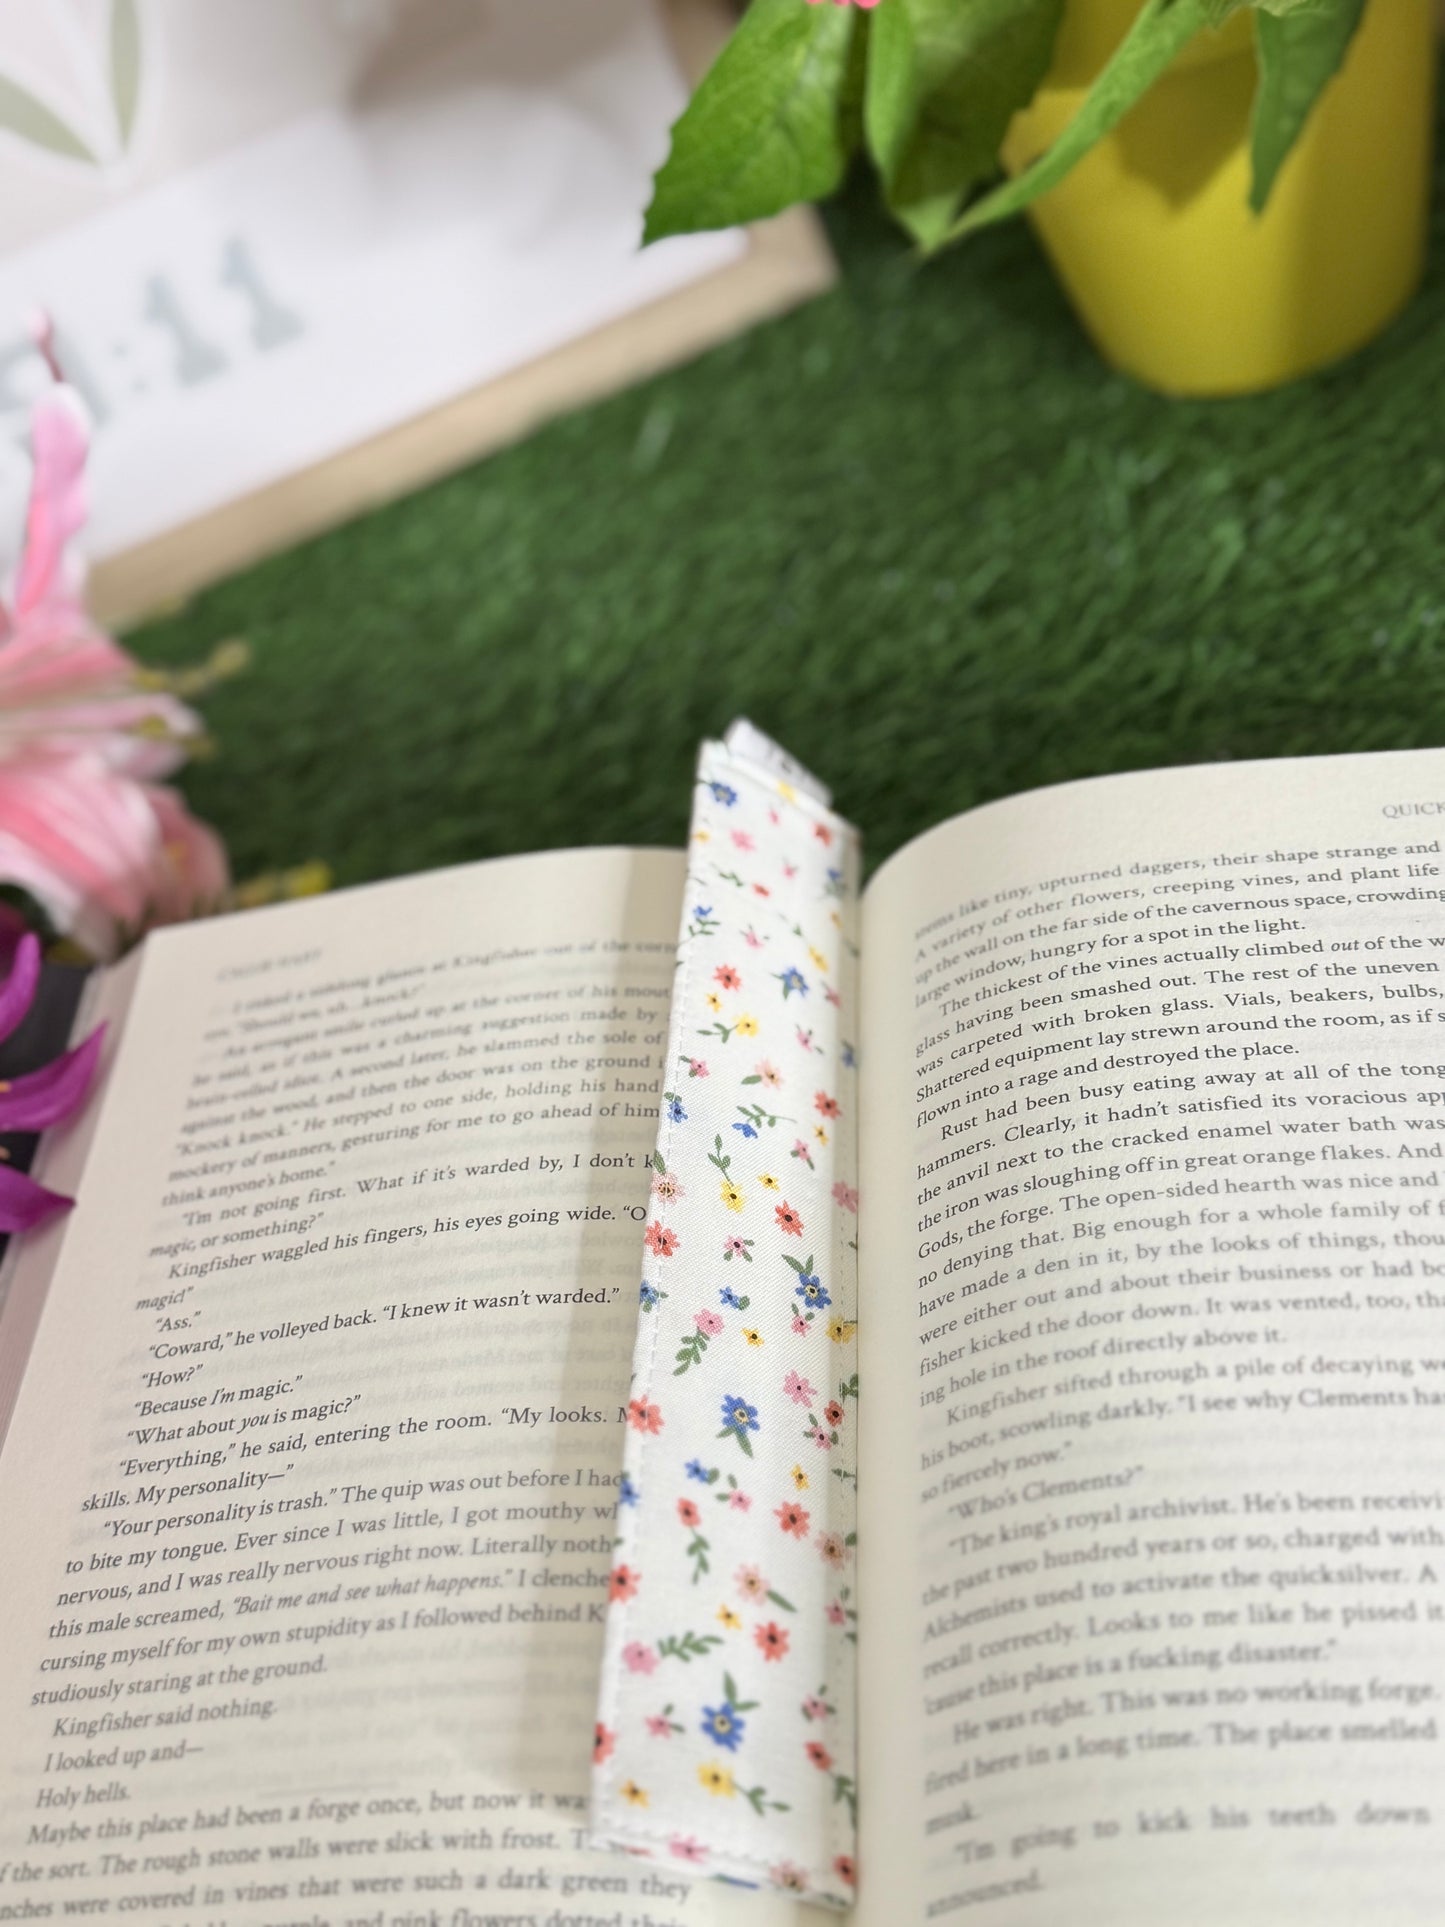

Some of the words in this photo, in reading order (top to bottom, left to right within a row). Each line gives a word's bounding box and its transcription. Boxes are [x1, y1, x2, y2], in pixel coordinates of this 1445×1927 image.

[916, 1029, 950, 1059] glass
[956, 1006, 1016, 1034] having
[1019, 994, 1064, 1012] been
[1070, 976, 1152, 1001] smashed
[1159, 975, 1197, 988] out.
[1203, 969, 1245, 984] The
[1252, 968, 1290, 981] rest
[1297, 963, 1319, 978] of
[1324, 963, 1357, 977] the
[1364, 962, 1440, 975] uneven
[939, 997, 970, 1017] The
[975, 973, 1043, 1002] thickest
[1048, 964, 1068, 981] of
[1071, 961, 1102, 976] the
[1106, 955, 1158, 970] vines
[1163, 945, 1240, 964] actually
[1245, 939, 1324, 957] climbed
[1331, 940, 1360, 952] out
[1364, 936, 1386, 950] of
[1389, 935, 1423, 949] the
[916, 1056, 944, 1078] was
[950, 1023, 1023, 1060] carpeted
[1031, 1012, 1075, 1033] with
[1083, 1004, 1152, 1023] broken
[1161, 997, 1214, 1017] glass.
[1223, 991, 1281, 1007] Vials,
[1290, 987, 1374, 1003] beakers,
[1381, 984, 1443, 999] bulbs,
[916, 1057, 990, 1103] Shattered
[995, 1036, 1093, 1068] equipment
[1097, 1031, 1126, 1047] lay
[1131, 1025, 1200, 1041] strewn
[1206, 1015, 1280, 1034] around
[1283, 1014, 1317, 1029] the
[1322, 1015, 1385, 1027] room,
[1390, 1013, 1411, 1024] as
[1416, 1008, 1433, 1023] if
[917, 1098, 962, 1128] flown
[965, 1084, 1000, 1105] into
[1004, 1080, 1015, 1091] a
[1018, 1069, 1058, 1087] rage
[1063, 1057, 1099, 1077] and
[1103, 1046, 1200, 1070] destroyed
[1204, 1044, 1237, 1059] the
[1241, 1041, 1299, 1061] place.
[941, 1116, 978, 1141] Rust
[985, 1099, 1018, 1123] had
[1025, 1093, 1071, 1111] been
[1078, 1083, 1125, 1100] busy
[1133, 1075, 1196, 1092] eating
[1204, 1072, 1257, 1087] away
[1265, 1069, 1285, 1082] at
[1293, 1065, 1319, 1080] all
[1328, 1063, 1350, 1078] of
[1357, 1062, 1392, 1077] the
[917, 1138, 996, 1180] hammers.
[1004, 1116, 1076, 1142] Clearly,
[1084, 1111, 1099, 1126] it
[1107, 1101, 1170, 1122] hadn’t
[1178, 1094, 1263, 1114] satisfied
[1271, 1093, 1297, 1108] its
[1305, 1090, 1407, 1106] voracious
[917, 1185, 941, 1206] the
[947, 1161, 990, 1191] anvil
[996, 1151, 1038, 1173] next
[1044, 1147, 1064, 1160] to
[1071, 1138, 1104, 1154] the
[1111, 1125, 1190, 1148] cracked
[1197, 1120, 1273, 1140] enamel
[1279, 1121, 1341, 1134] water
[1347, 1115, 1397, 1132] bath
[1403, 1119, 1445, 1130] was
[219, 1204, 248, 1221] not
[252, 1196, 300, 1218] going
[307, 1187, 346, 1204] first.
[356, 1176, 405, 1194] What
[412, 1168, 428, 1185] if
[432, 1165, 456, 1182] it’s
[465, 1156, 530, 1177] warded
[539, 1155, 563, 1173] by,
[573, 1154, 580, 1168] I
[589, 1153, 635, 1168] don’t
[918, 1212, 942, 1233] the
[944, 1197, 980, 1219] iron
[984, 1184, 1019, 1203] was
[1023, 1165, 1121, 1193] sloughing
[1125, 1156, 1156, 1174] off
[1158, 1156, 1180, 1171] in
[1184, 1153, 1238, 1173] great
[1242, 1150, 1316, 1166] orange
[1320, 1144, 1391, 1161] flakes.
[1397, 1142, 1443, 1159] And
[167, 1253, 257, 1279] Kingfisher
[261, 1236, 330, 1262] waggled
[333, 1233, 359, 1250] his
[363, 1225, 427, 1244] fingers,
[433, 1217, 460, 1233] his
[465, 1215, 503, 1232] eyes
[507, 1208, 560, 1229] going
[566, 1205, 616, 1221] wide.
[149, 1331, 233, 1360] “Coward,”
[234, 1330, 255, 1346] he
[259, 1315, 330, 1342] volleyed
[333, 1309, 377, 1329] back.
[382, 1305, 397, 1320] “I
[400, 1302, 451, 1319] knew
[454, 1297, 469, 1312] it
[472, 1289, 531, 1309] wasn’t
[535, 1287, 620, 1305] warded.”
[156, 1310, 202, 1333] “Ass.”
[134, 1396, 208, 1417] “Because
[210, 1387, 236, 1406] I’m
[238, 1374, 303, 1401] magic.”
[141, 1363, 204, 1388] “How?”
[119, 1442, 237, 1477] “Everything,”
[239, 1441, 262, 1459] he
[267, 1432, 307, 1454] said,
[314, 1424, 391, 1447] entering
[398, 1417, 429, 1435] the
[435, 1415, 492, 1431] room.
[501, 1407, 543, 1428] “My
[548, 1405, 607, 1423] looks.
[127, 1426, 184, 1445] “What
[186, 1418, 236, 1438] about
[236, 1414, 270, 1435] you
[272, 1408, 287, 1424] is
[290, 1394, 361, 1422] magic?”
[81, 1490, 130, 1512] skills.
[134, 1485, 167, 1506] My
[166, 1463, 294, 1504] personality—”
[104, 1519, 154, 1538] “Your
[153, 1503, 257, 1536] personality
[258, 1499, 274, 1516] is
[278, 1487, 338, 1513] trash.”
[341, 1484, 378, 1504] The
[381, 1480, 424, 1503] quip
[428, 1479, 465, 1493] was
[469, 1474, 503, 1490] out
[507, 1469, 570, 1488] before
[574, 1469, 583, 1486] I
